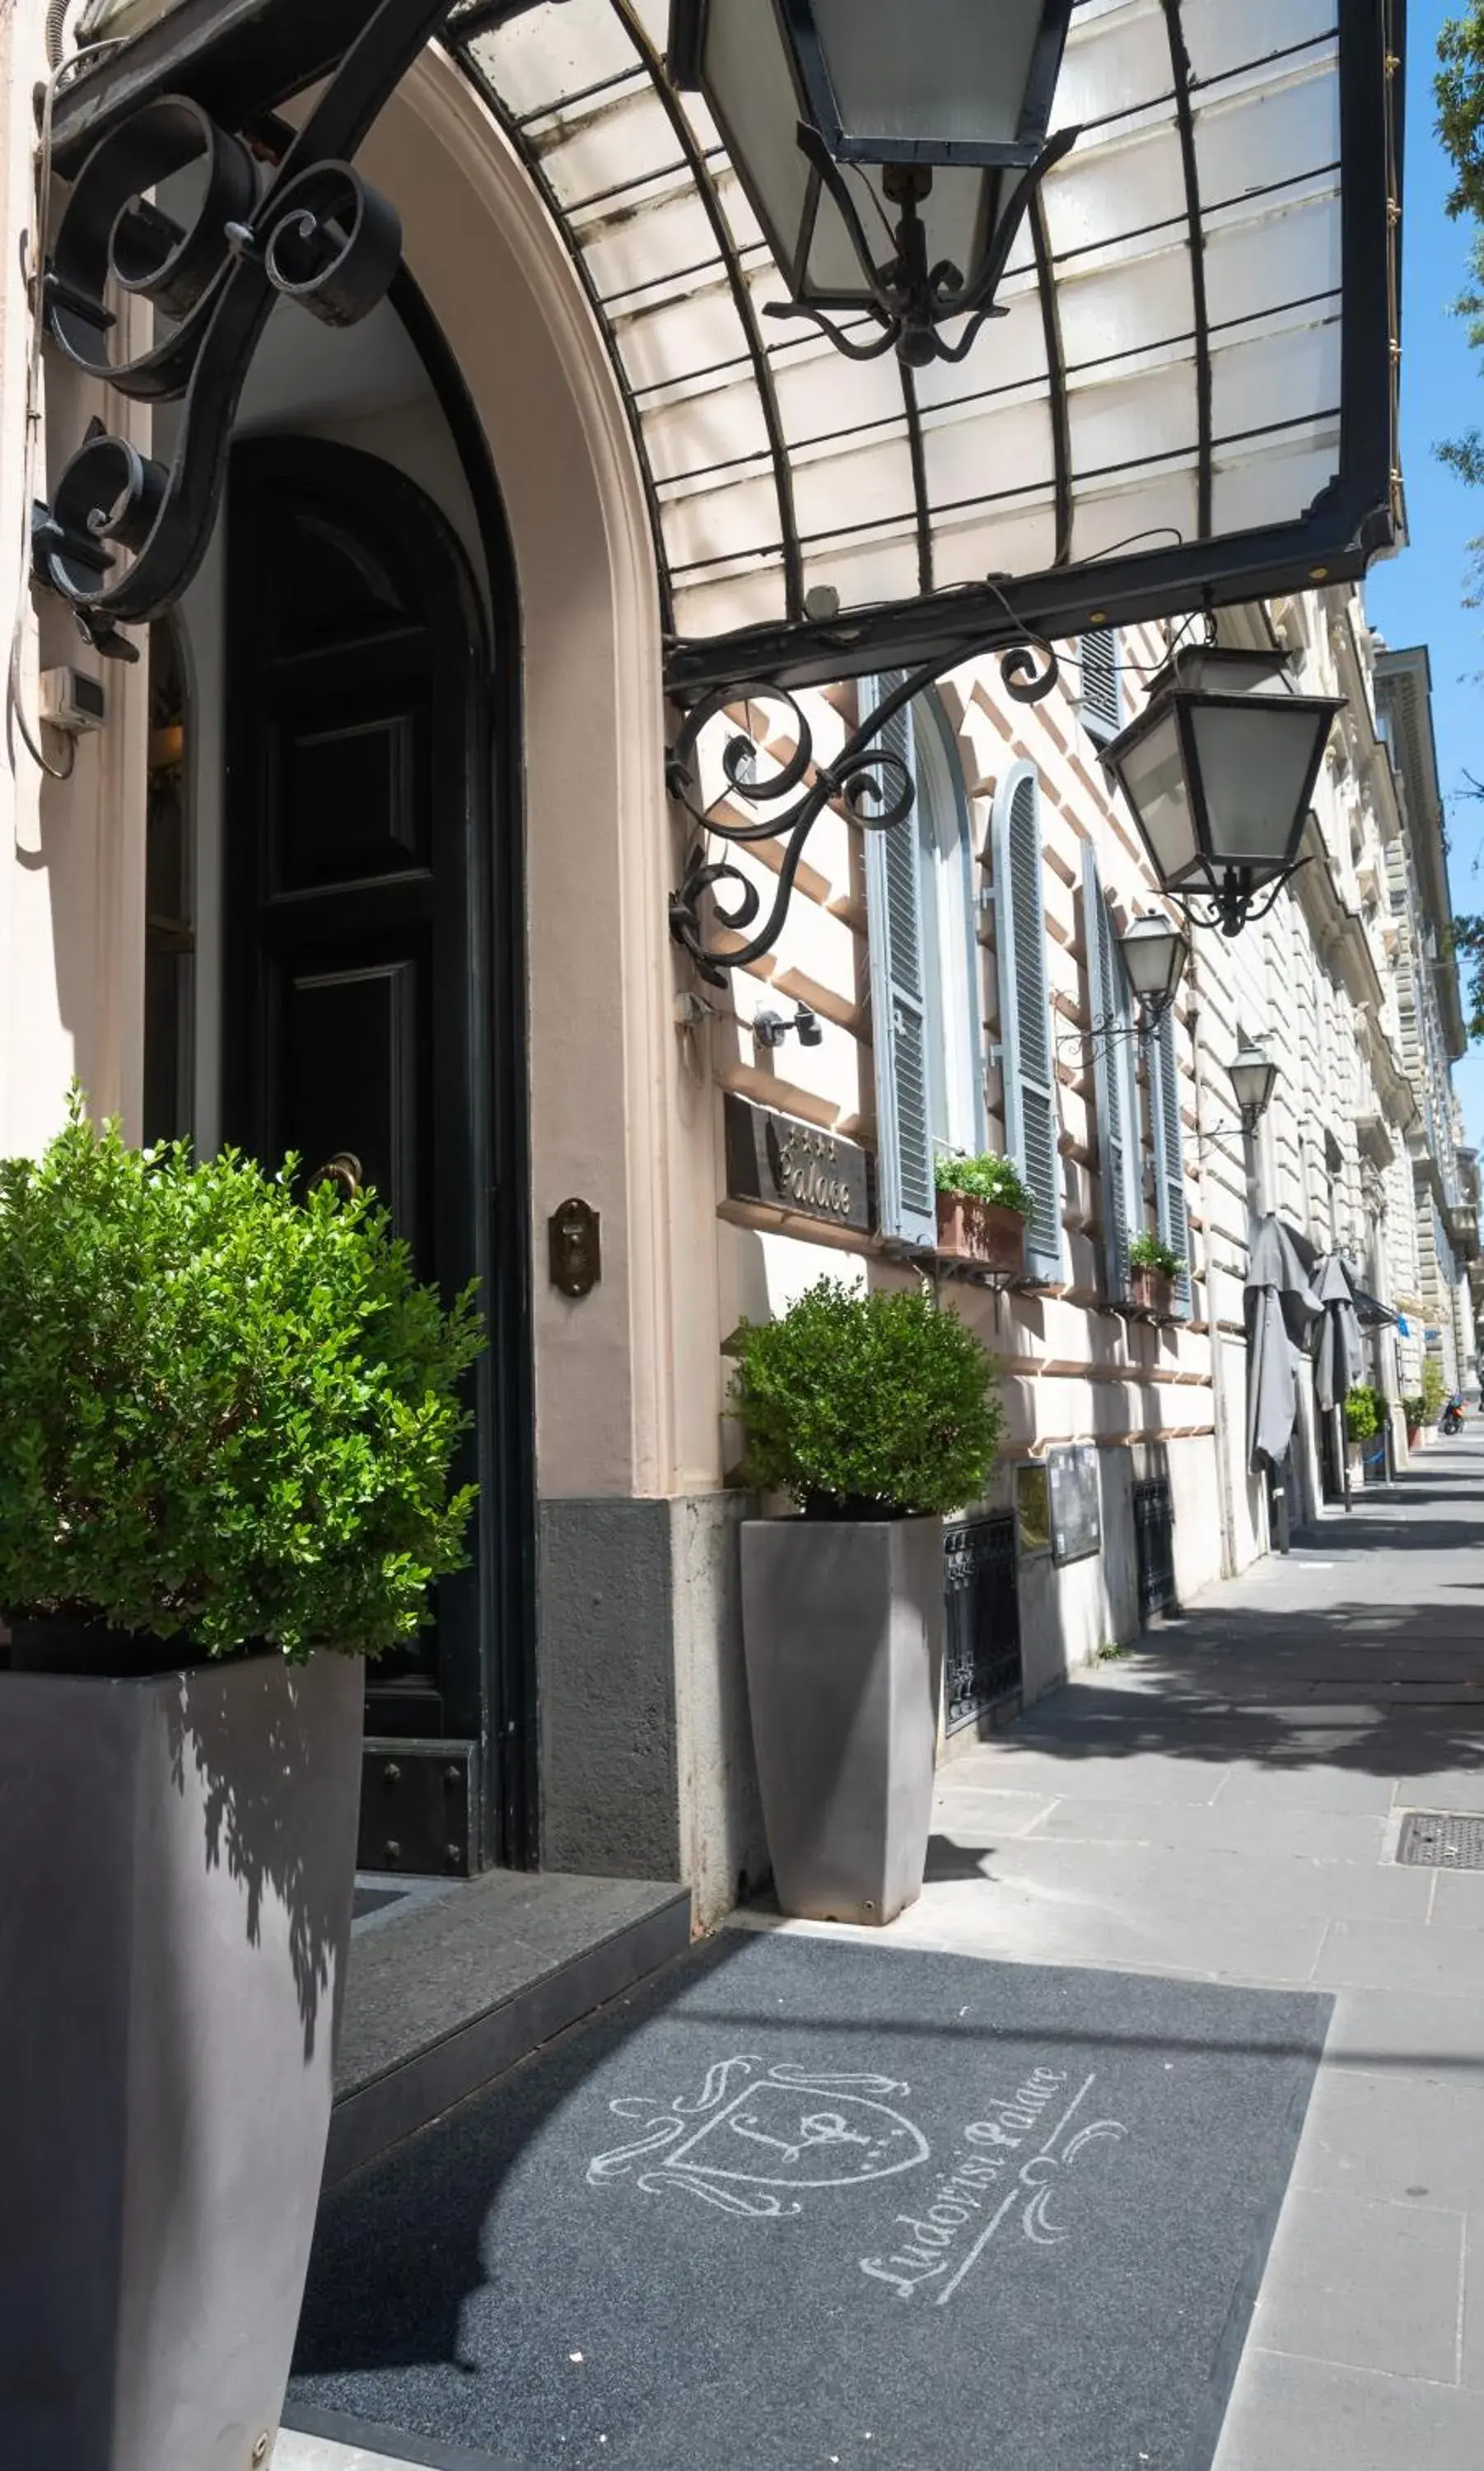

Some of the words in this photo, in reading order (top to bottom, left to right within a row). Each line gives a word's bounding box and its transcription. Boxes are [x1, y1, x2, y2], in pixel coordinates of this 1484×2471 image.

[779, 1144, 850, 1213] Palace
[859, 2150, 1005, 2298] Ludovisi
[964, 2067, 1067, 2147] Palace
